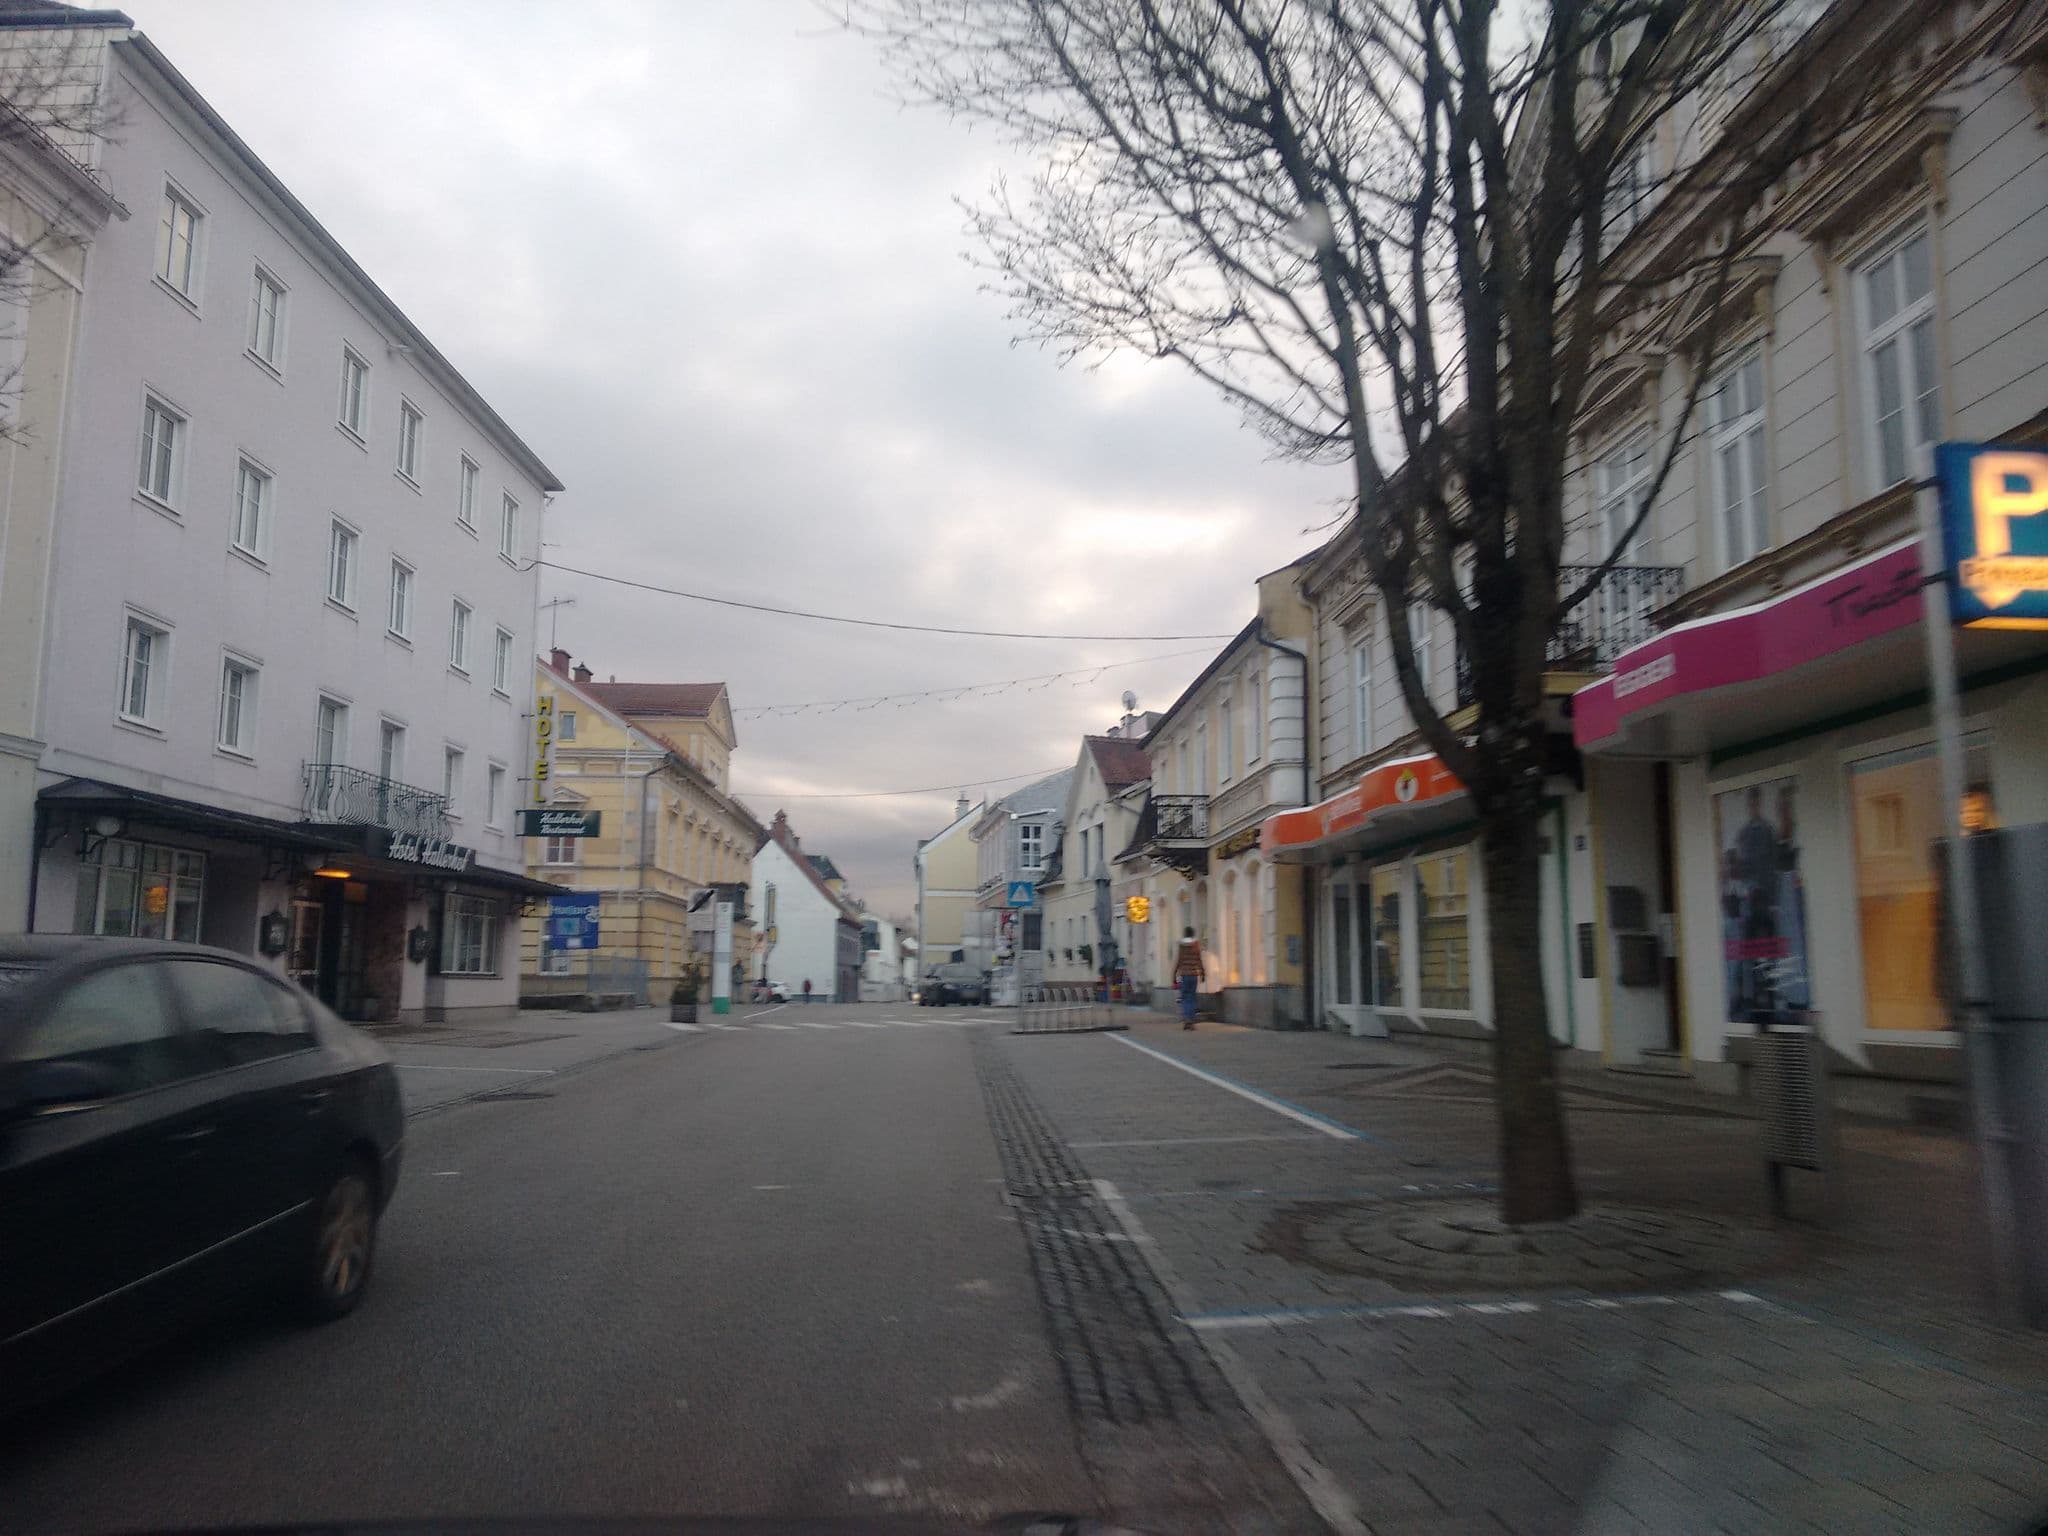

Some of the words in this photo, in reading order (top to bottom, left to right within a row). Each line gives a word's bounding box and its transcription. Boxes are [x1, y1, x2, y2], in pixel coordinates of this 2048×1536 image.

[1970, 452, 2048, 558] P
[534, 696, 552, 803] HOTEL
[389, 831, 421, 862] Hotel
[540, 812, 587, 825] Hallerhof
